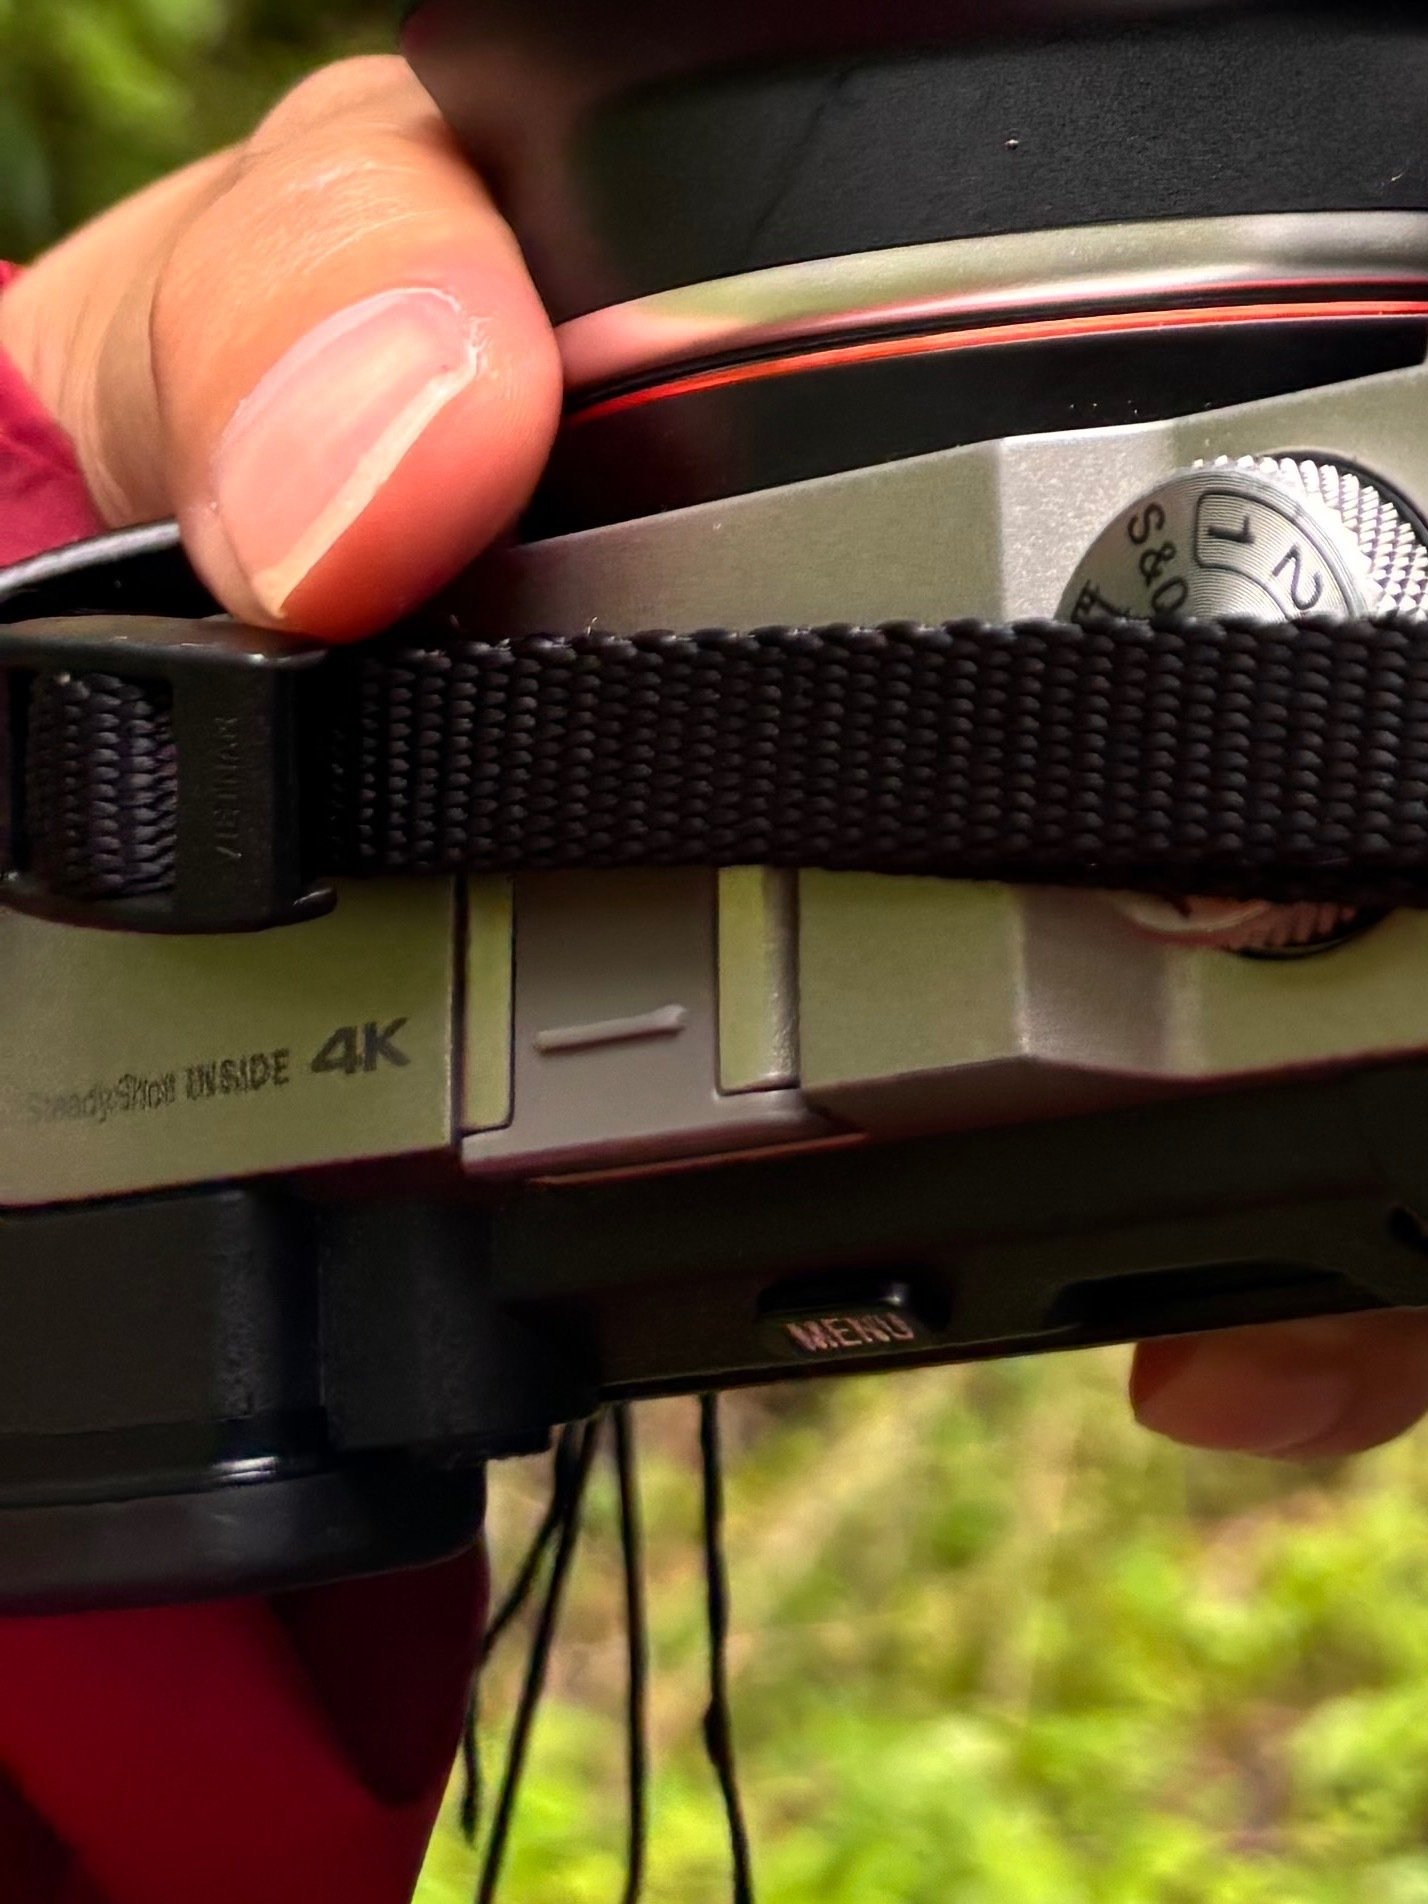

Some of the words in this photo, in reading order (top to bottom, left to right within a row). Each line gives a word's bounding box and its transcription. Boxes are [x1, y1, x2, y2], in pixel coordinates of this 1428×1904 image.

[1271, 544, 1324, 612] 2
[185, 1047, 291, 1103] INSIDE
[309, 1016, 412, 1076] 4K
[784, 1311, 915, 1353] MENU
